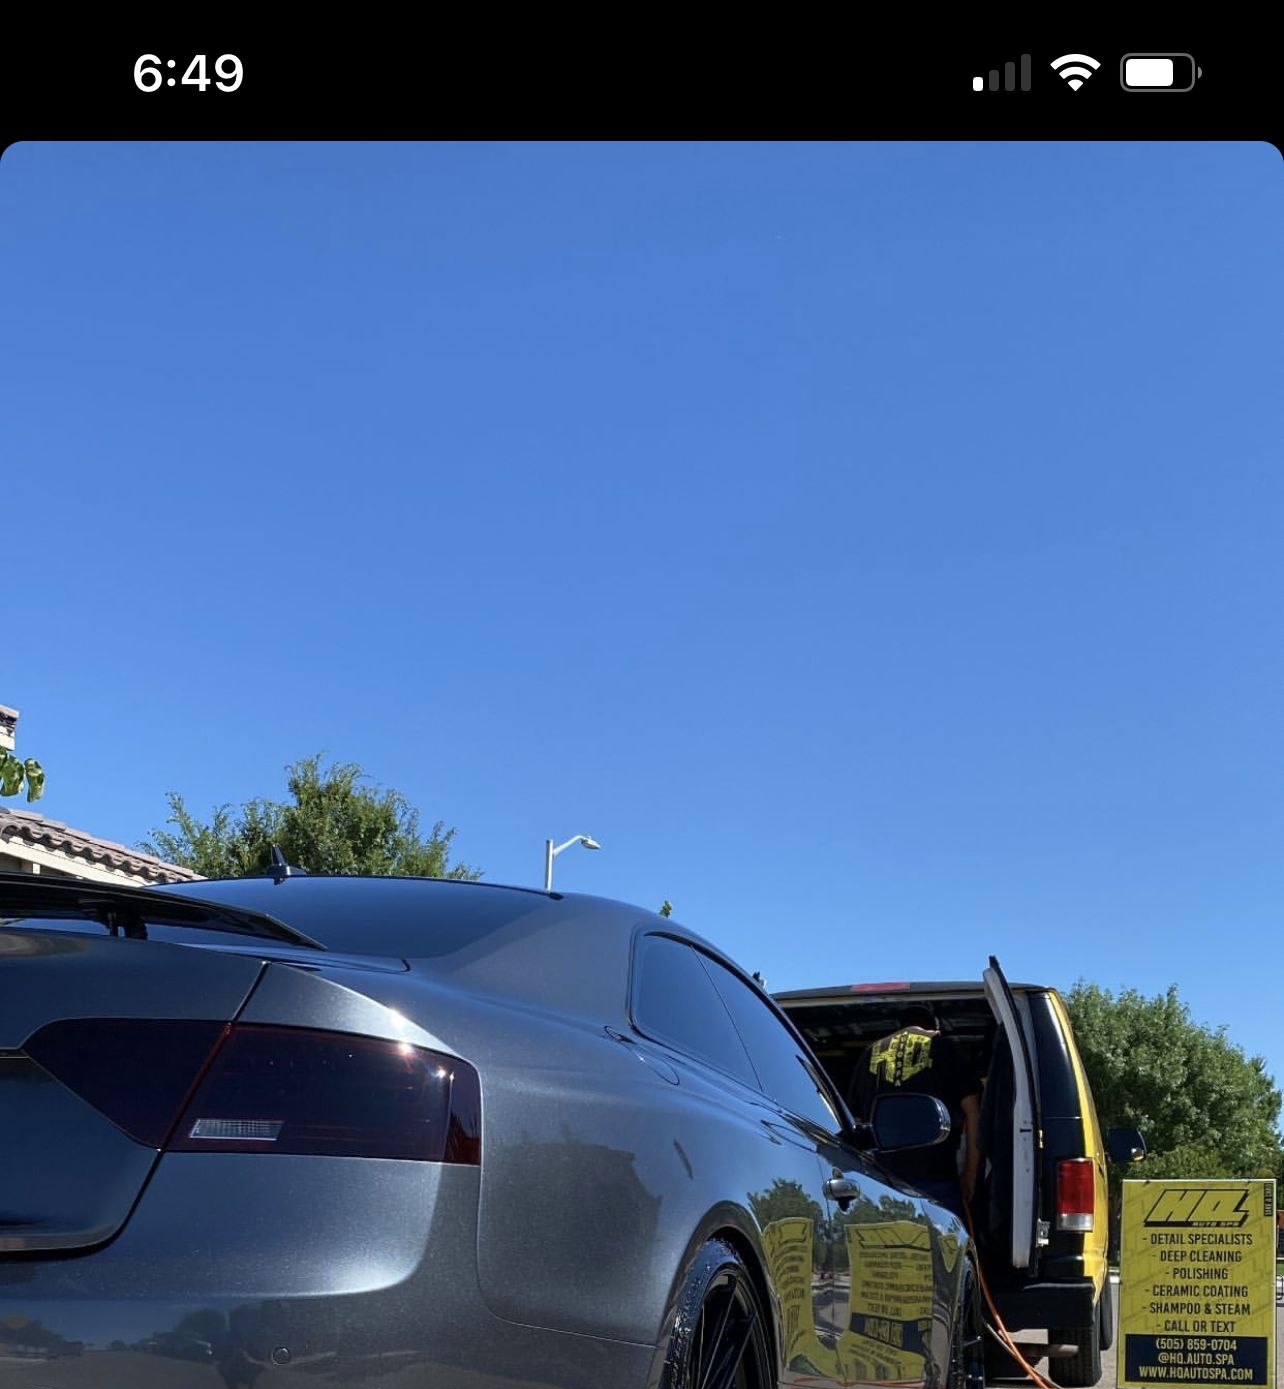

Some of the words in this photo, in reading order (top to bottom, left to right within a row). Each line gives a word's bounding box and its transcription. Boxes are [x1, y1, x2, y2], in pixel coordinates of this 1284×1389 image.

[1150, 1233, 1186, 1245] DETAIL
[1187, 1233, 1253, 1246] SPECIALISTS
[1160, 1250, 1187, 1262] DEEP
[1189, 1250, 1242, 1263] CLEANING
[1172, 1267, 1228, 1280] POLISHING
[1152, 1284, 1200, 1297] CERAMIC
[1202, 1285, 1248, 1298] COATING
[1149, 1302, 1201, 1314] SHAMPOO
[1204, 1302, 1212, 1315] &
[1215, 1303, 1251, 1316] STEAM
[1164, 1320, 1190, 1332] CALL
[1193, 1321, 1208, 1333] OR
[1211, 1321, 1236, 1333] TEXT
[1156, 1338, 1184, 1350] (505)
[1187, 1338, 1237, 1351] 859-0704
[1158, 1352, 1235, 1366] @HQ.AUTO.SPA
[1138, 1366, 1254, 1381] WWW.HQAUTOSPA.COM
